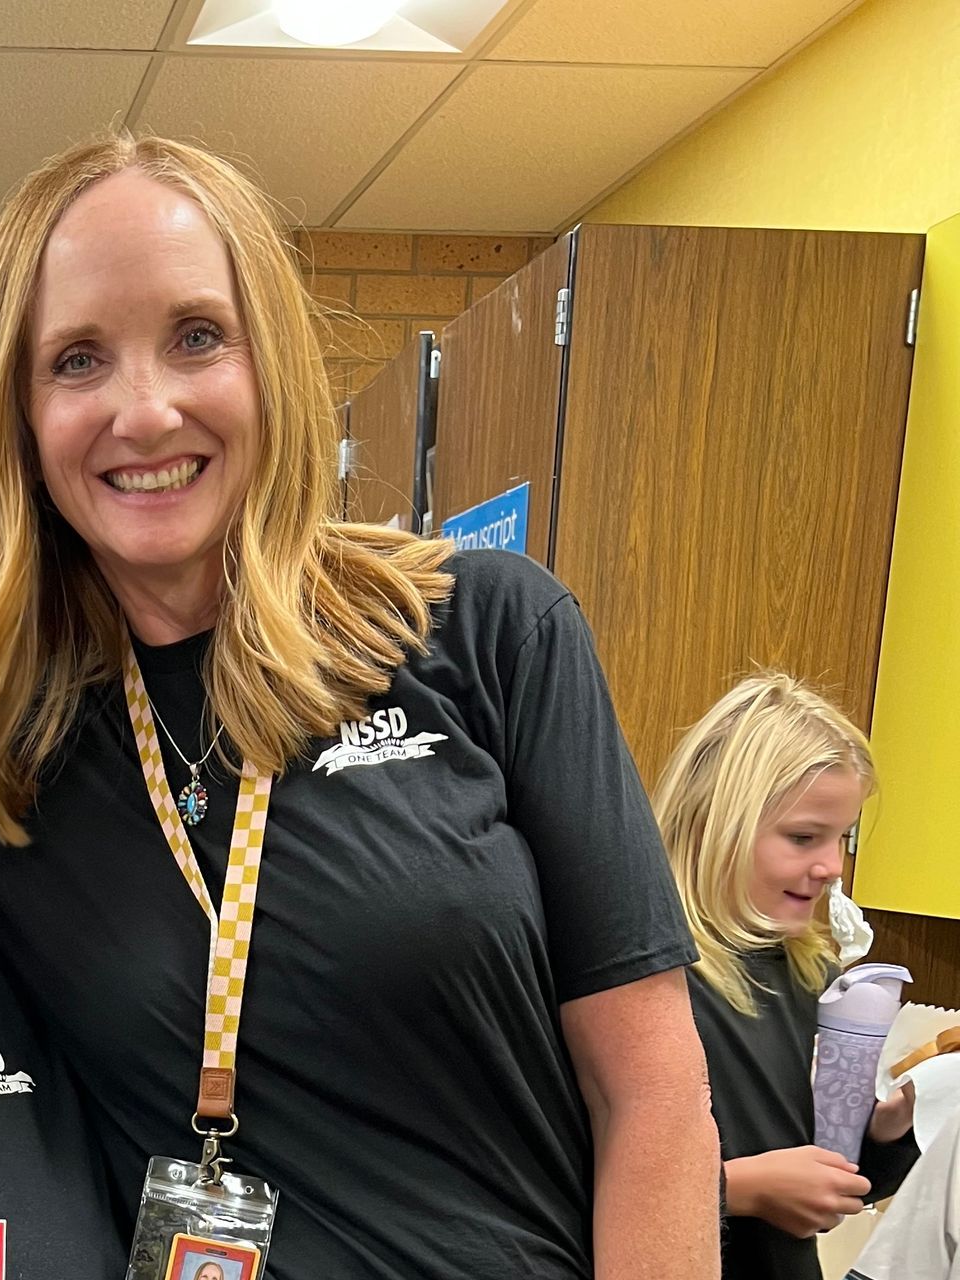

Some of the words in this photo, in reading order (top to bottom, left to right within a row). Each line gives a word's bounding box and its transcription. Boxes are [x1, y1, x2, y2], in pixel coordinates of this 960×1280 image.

[341, 707, 408, 746] NSSD
[348, 754, 372, 763] ONE
[376, 748, 407, 760] TEAM
